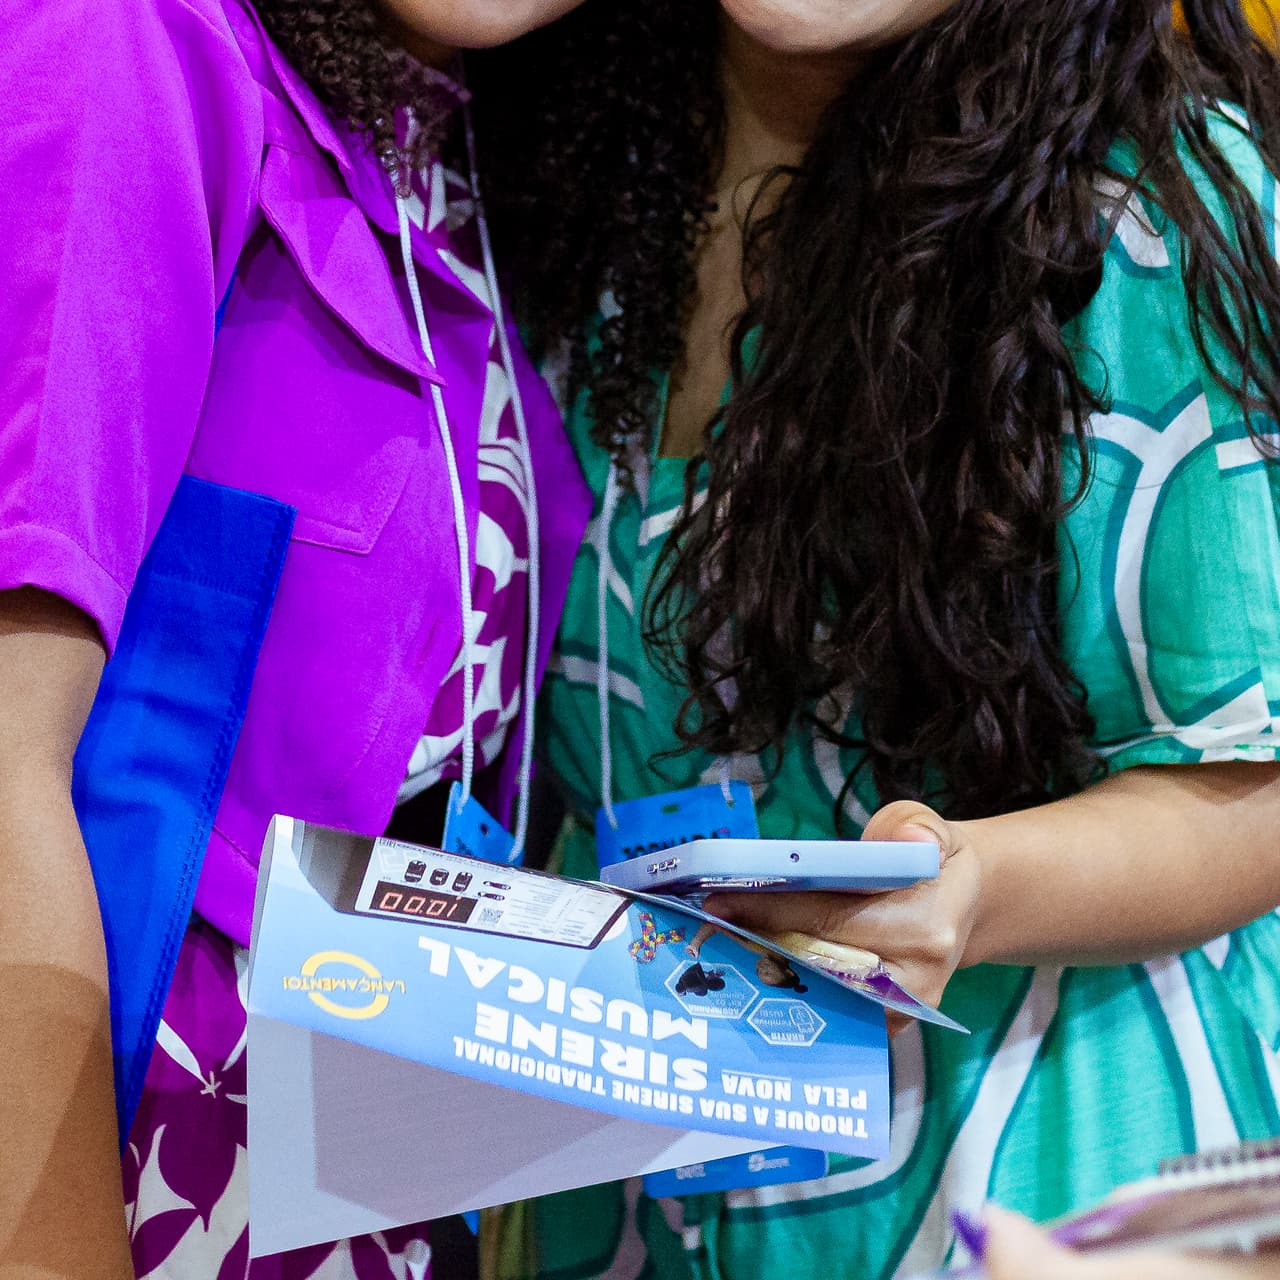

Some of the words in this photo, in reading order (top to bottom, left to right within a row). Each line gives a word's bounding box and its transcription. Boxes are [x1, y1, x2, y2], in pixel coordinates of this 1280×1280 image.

[418, 935, 708, 1050] MUSICAL
[475, 1001, 708, 1092] SIRENE
[453, 1035, 607, 1097] TRADICIONAL
[611, 1080, 694, 1115] SIRENE
[721, 1073, 792, 1103] NOVA
[803, 1083, 868, 1111] PELA
[699, 1097, 748, 1123] SUA
[752, 1105, 770, 1127] A
[775, 1108, 869, 1139] TROQUE
